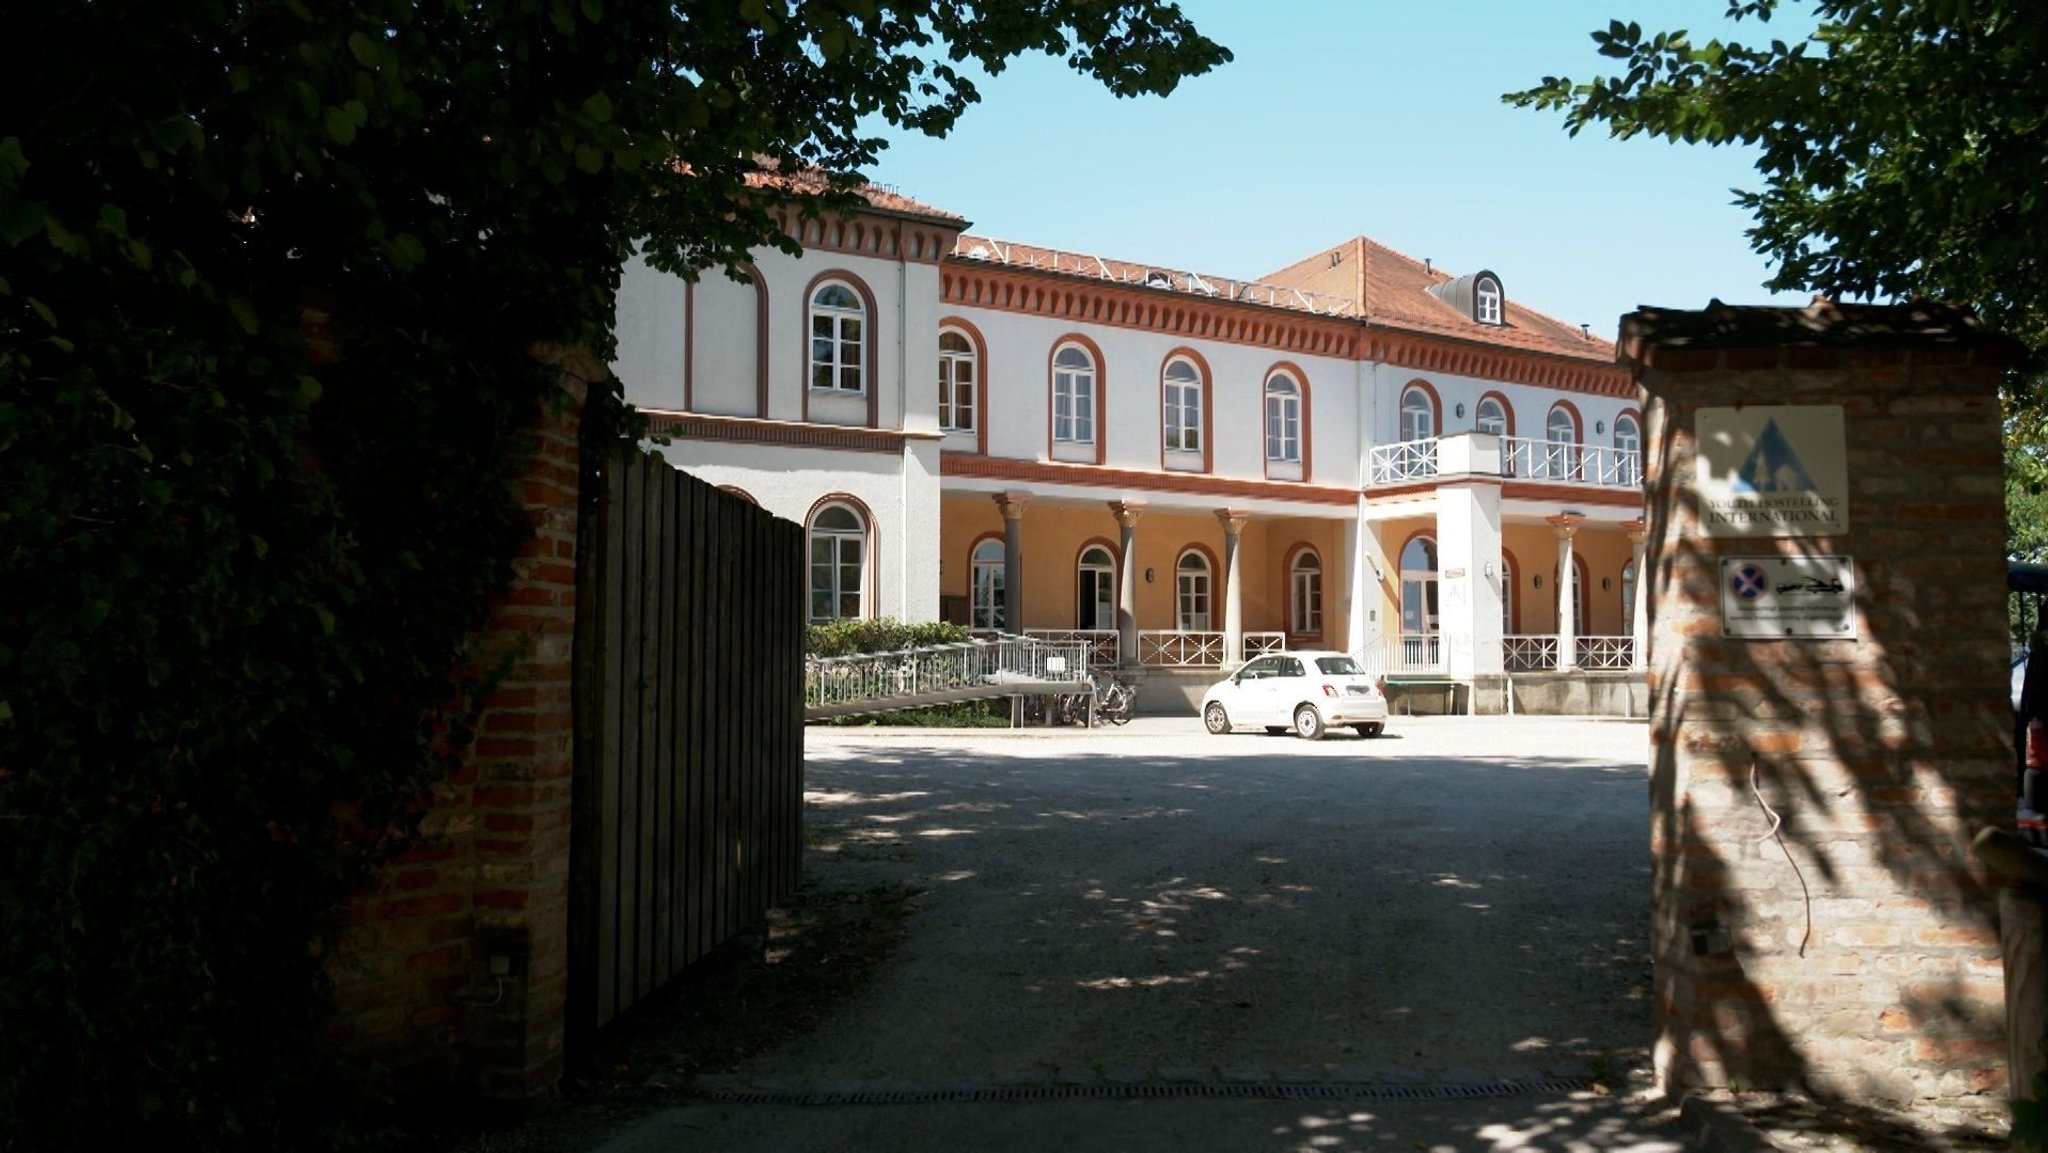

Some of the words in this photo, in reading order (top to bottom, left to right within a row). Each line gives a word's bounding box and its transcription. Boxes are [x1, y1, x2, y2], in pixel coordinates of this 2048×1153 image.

[1709, 498, 1756, 509] YOUTH
[1759, 497, 1839, 509] HOSTELLING
[1709, 510, 1838, 524] INTERNATIONAL
